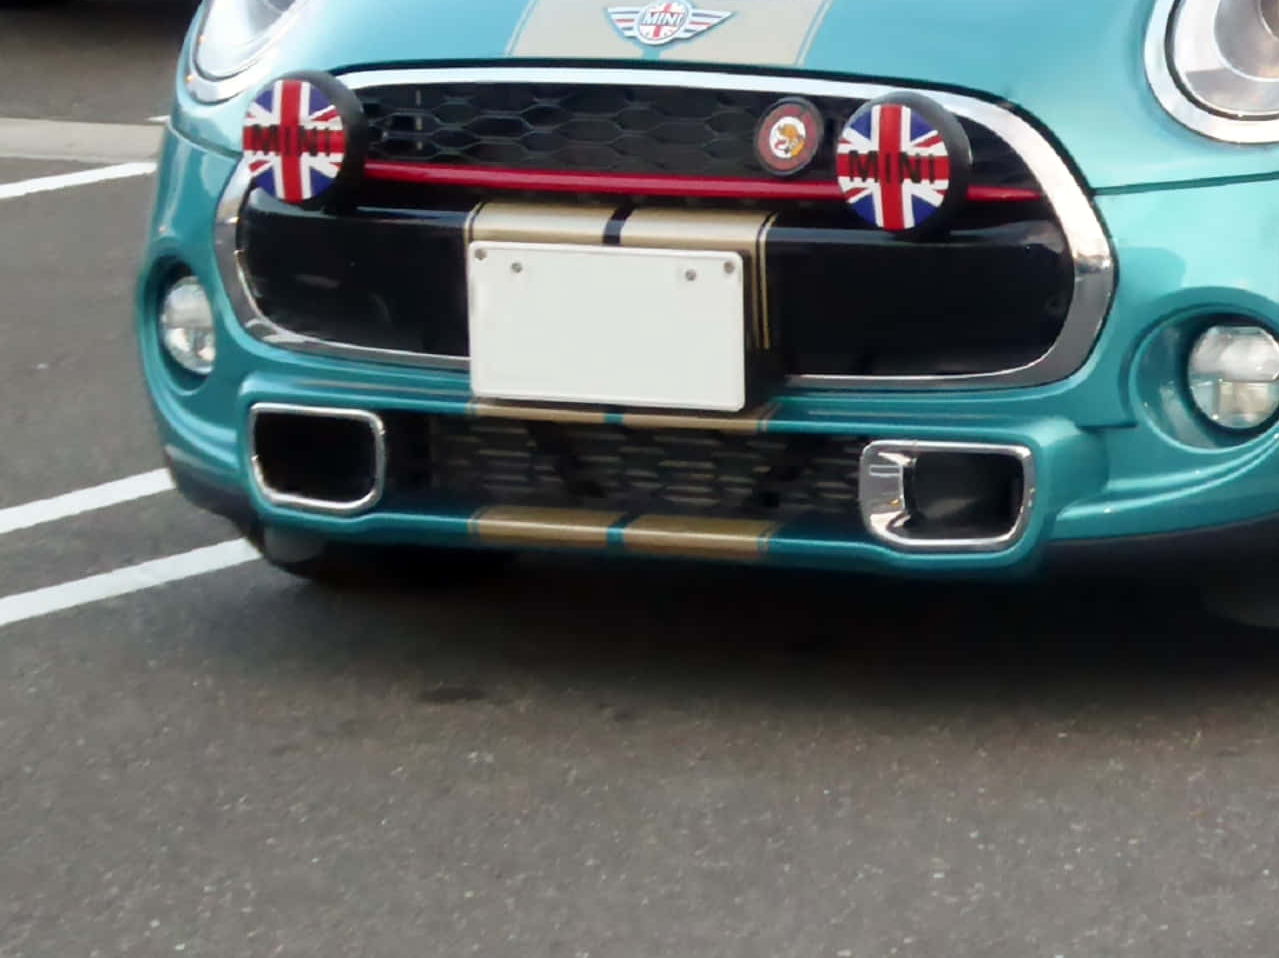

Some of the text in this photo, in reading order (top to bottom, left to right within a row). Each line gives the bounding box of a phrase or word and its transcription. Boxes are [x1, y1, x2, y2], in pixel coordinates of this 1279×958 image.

[642, 11, 685, 27] MINI
[251, 124, 331, 157] MINI
[848, 150, 936, 185] MINI
